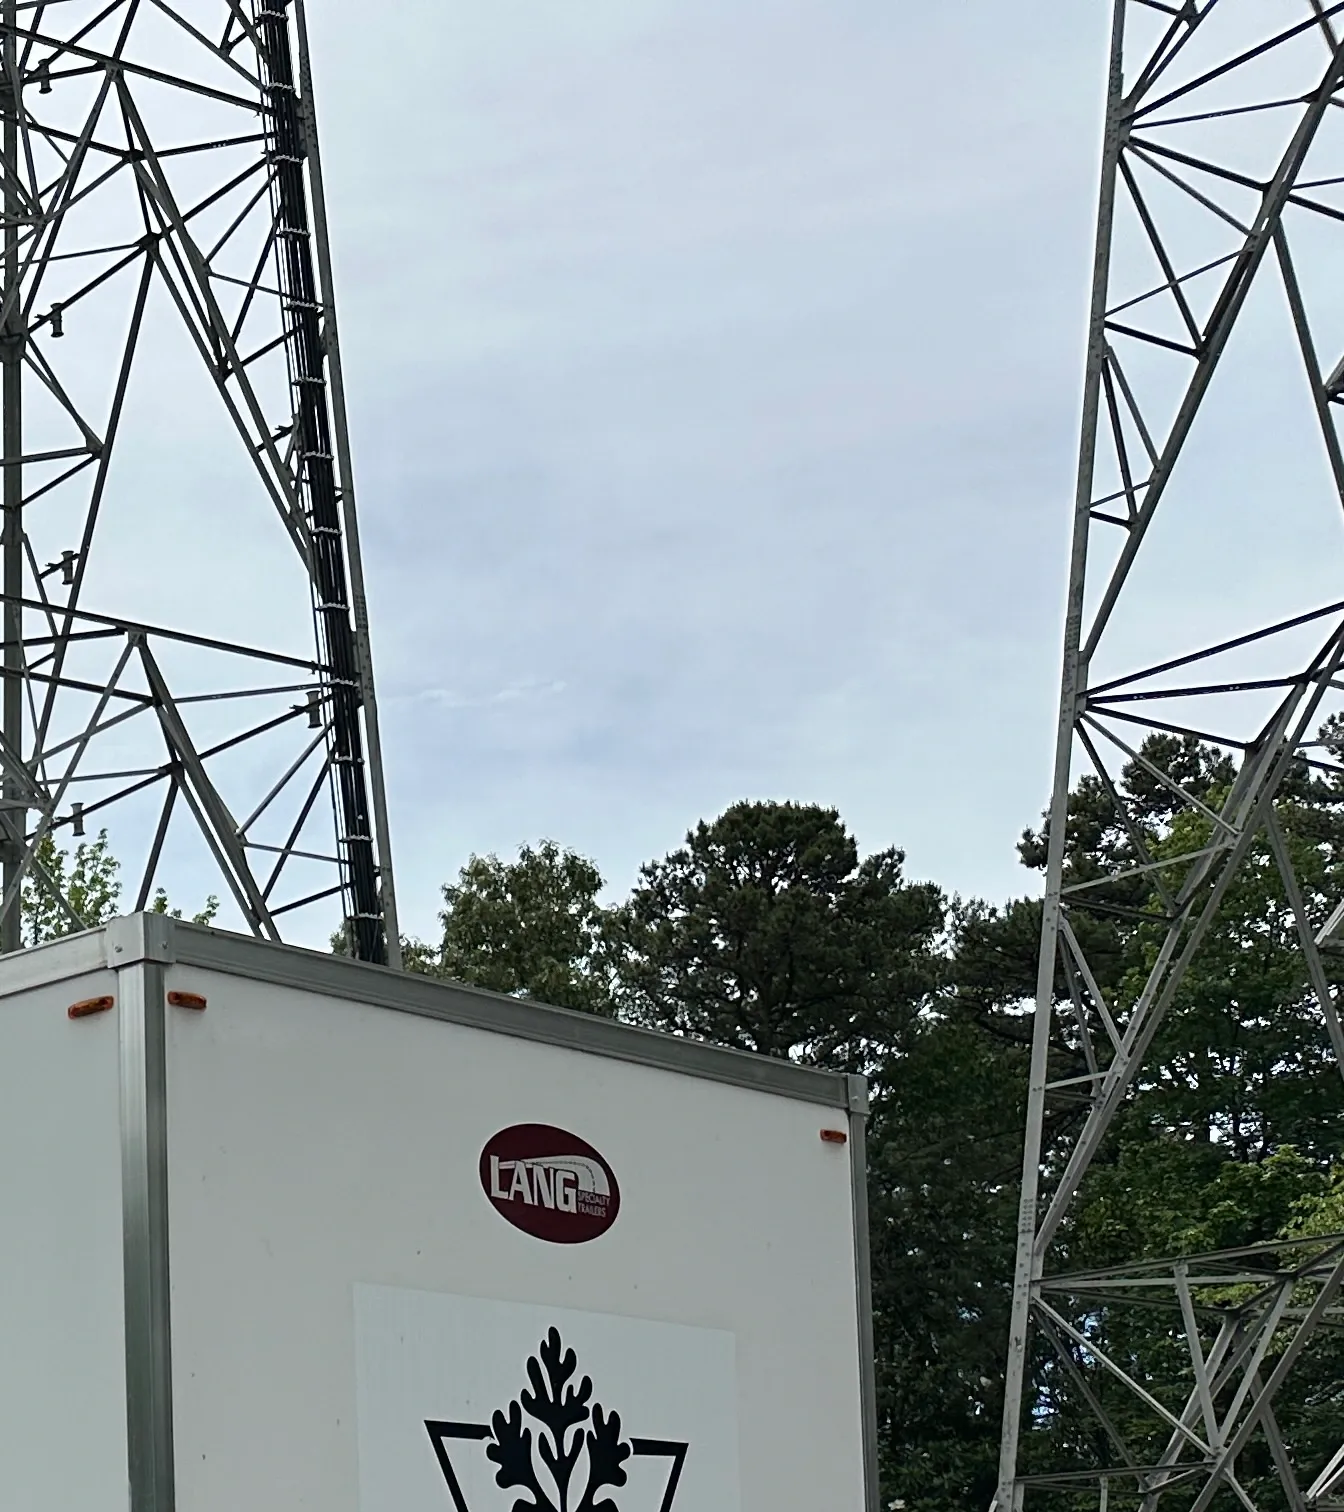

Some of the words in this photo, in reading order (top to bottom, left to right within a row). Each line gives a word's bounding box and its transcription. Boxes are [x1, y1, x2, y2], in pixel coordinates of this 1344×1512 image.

[490, 1155, 577, 1213] LANG
[578, 1190, 610, 1206] SPECIALTY
[578, 1203, 607, 1218] TRAILERS
